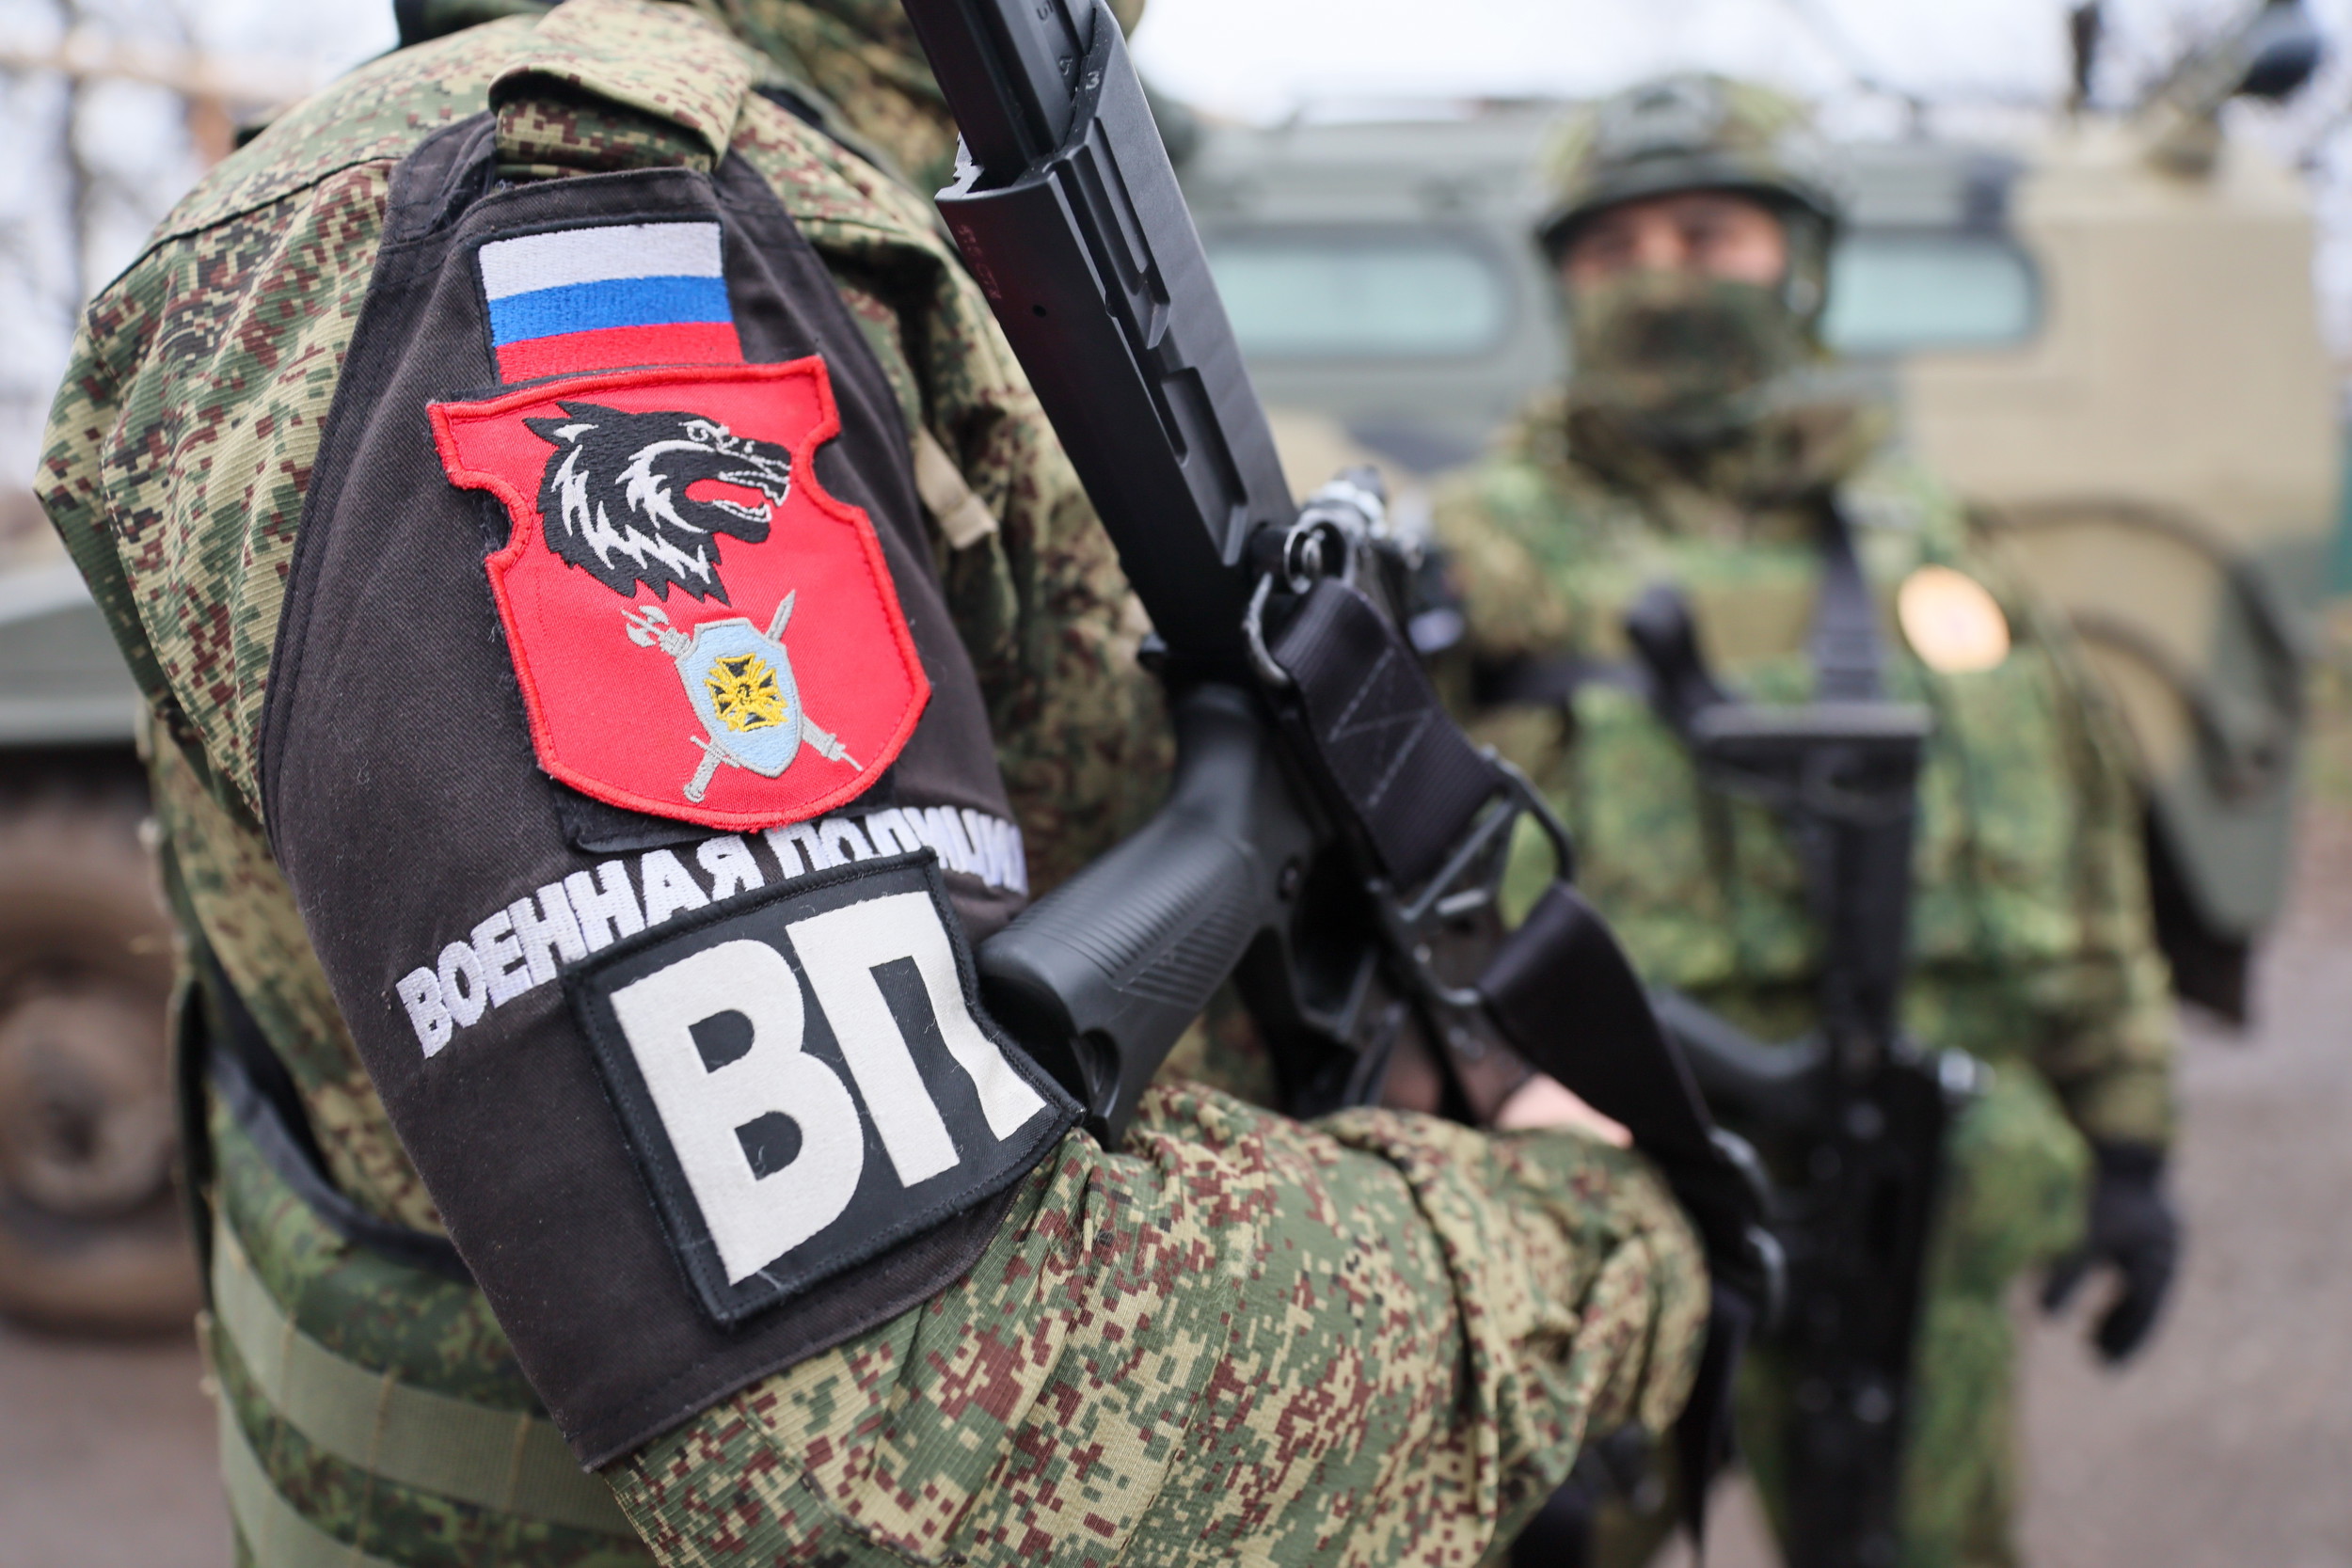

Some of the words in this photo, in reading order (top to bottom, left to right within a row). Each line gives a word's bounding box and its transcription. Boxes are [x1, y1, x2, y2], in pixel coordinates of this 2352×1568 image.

[395, 834, 765, 1059] ВОЕННАЯ
[763, 805, 1029, 897] ПОЛИЦИ
[609, 891, 1048, 1287] ВП
